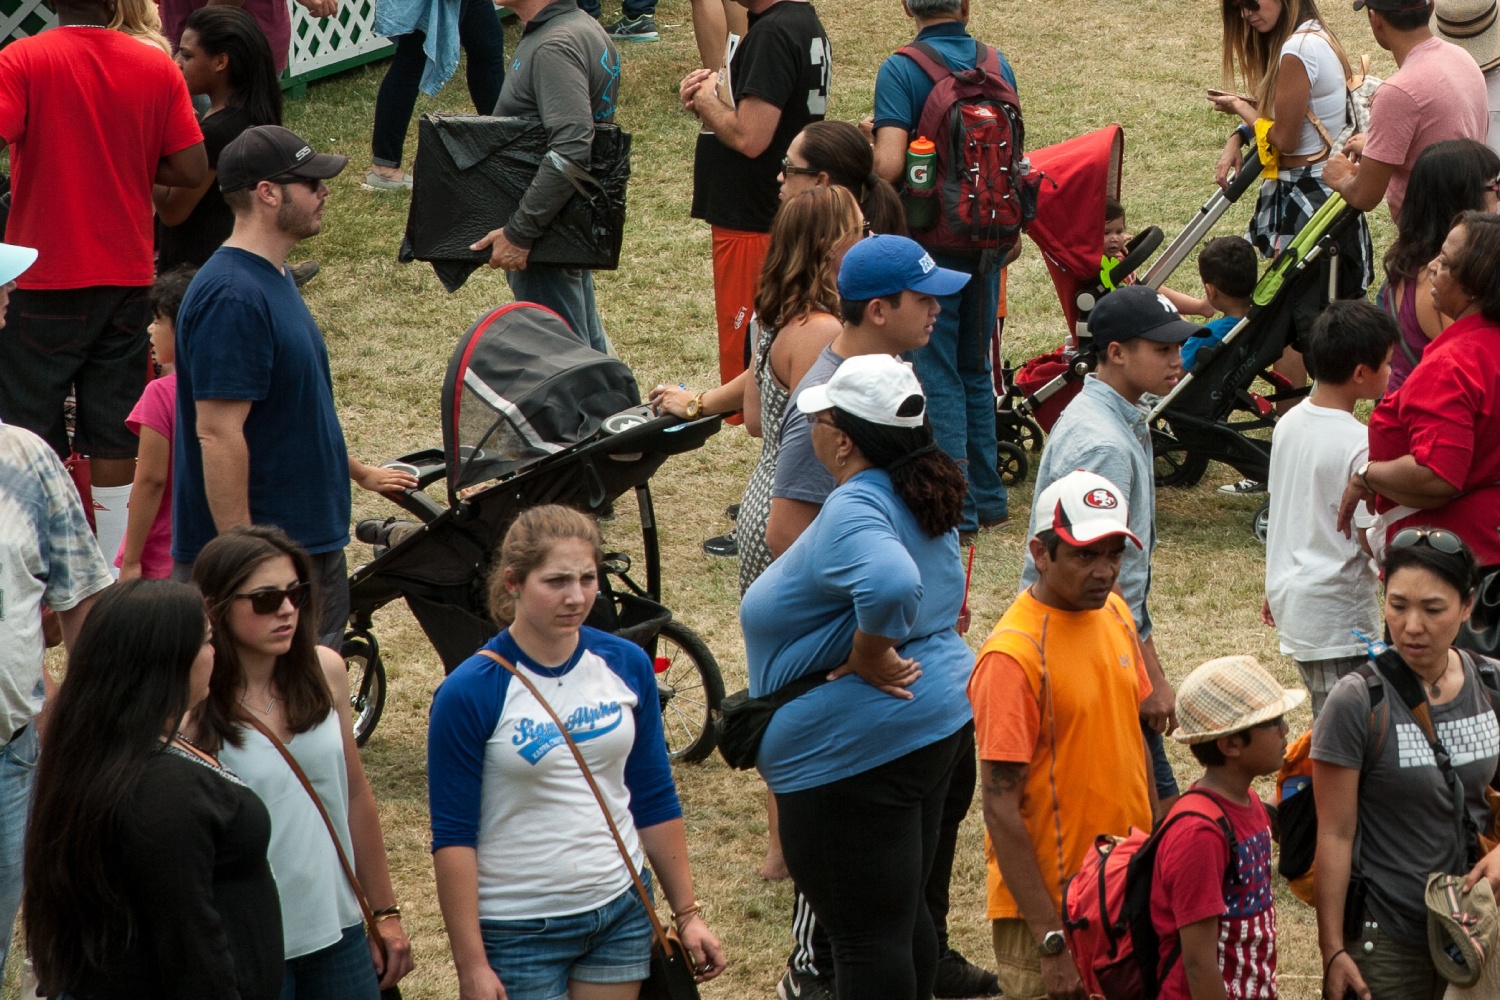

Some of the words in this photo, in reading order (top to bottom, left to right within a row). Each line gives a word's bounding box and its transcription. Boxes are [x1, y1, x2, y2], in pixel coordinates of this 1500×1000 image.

[910, 165, 928, 184] G
[512, 717, 561, 746] Sigm
[563, 700, 621, 731] Alpha
